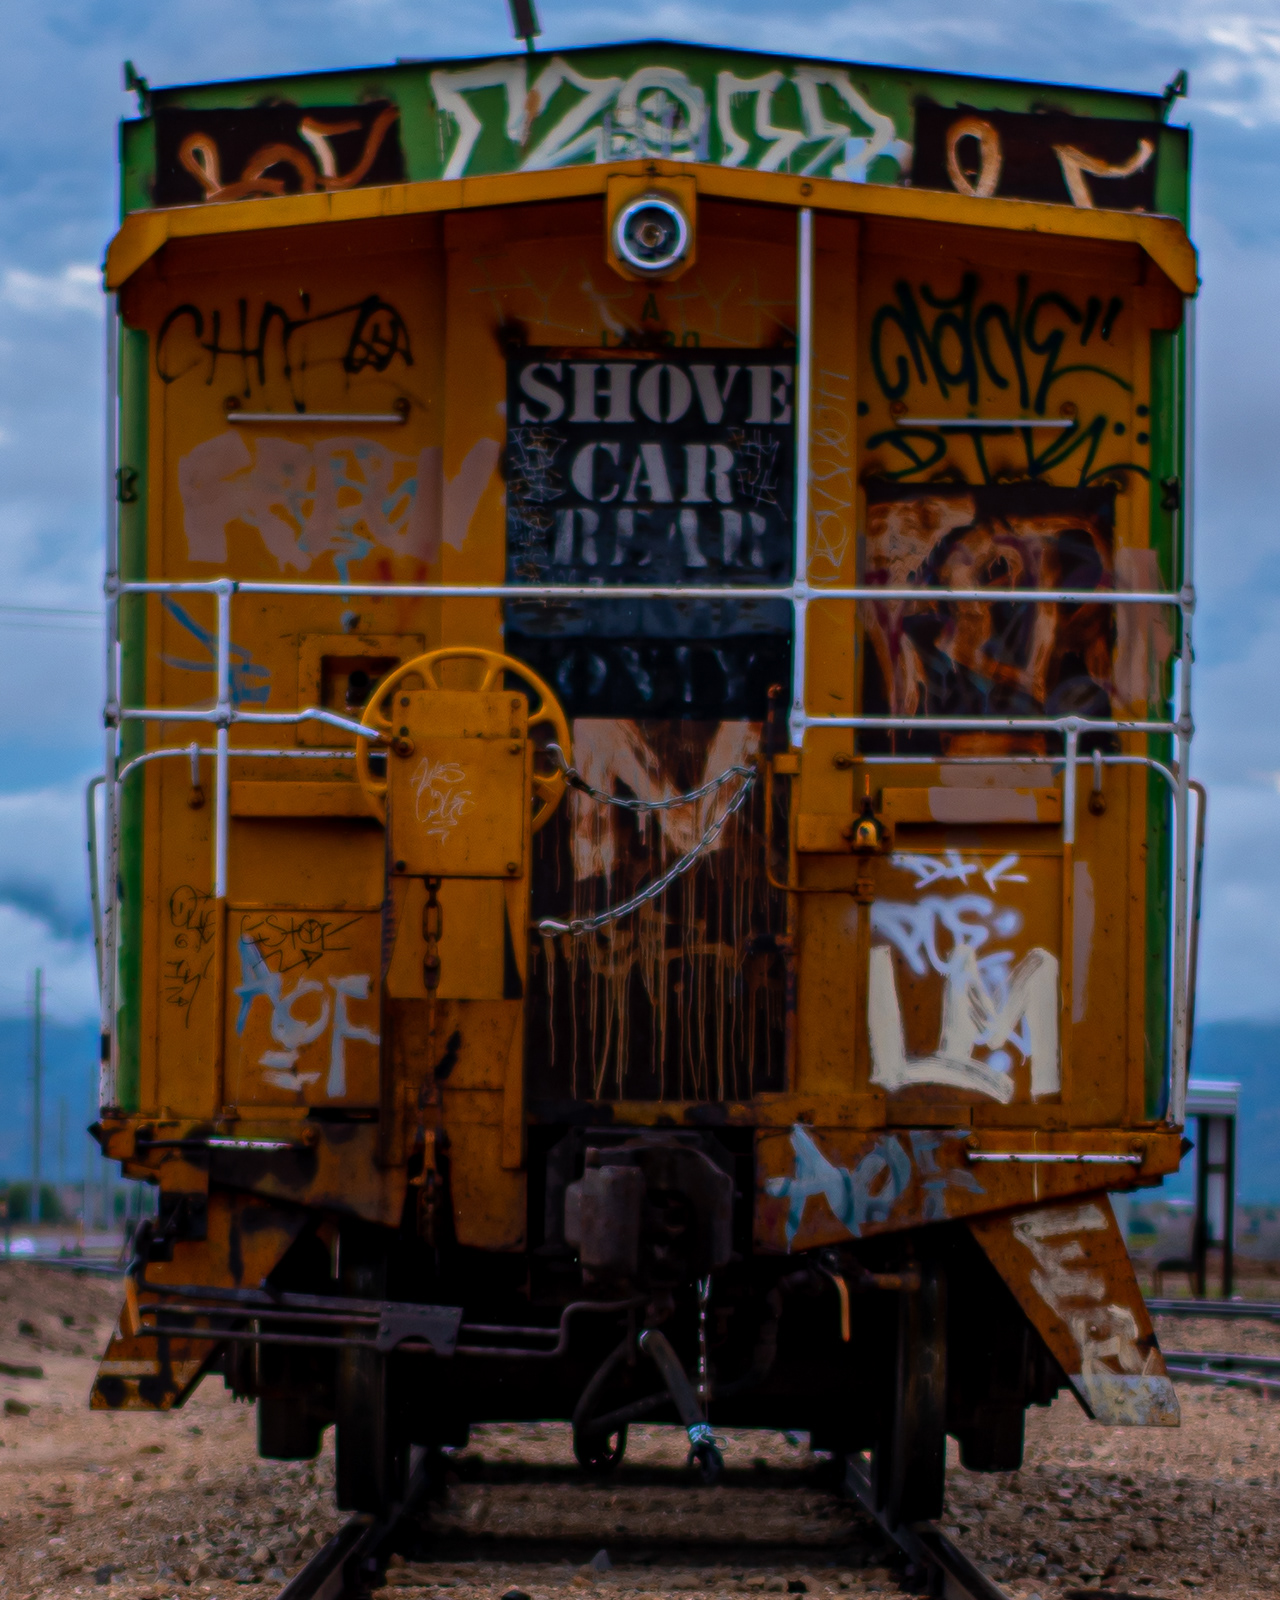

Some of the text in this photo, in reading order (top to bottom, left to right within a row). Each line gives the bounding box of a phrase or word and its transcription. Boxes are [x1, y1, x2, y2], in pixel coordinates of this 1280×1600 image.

[519, 361, 792, 425] SHOVE
[571, 442, 735, 504] CAR
[553, 507, 767, 568] REAR
